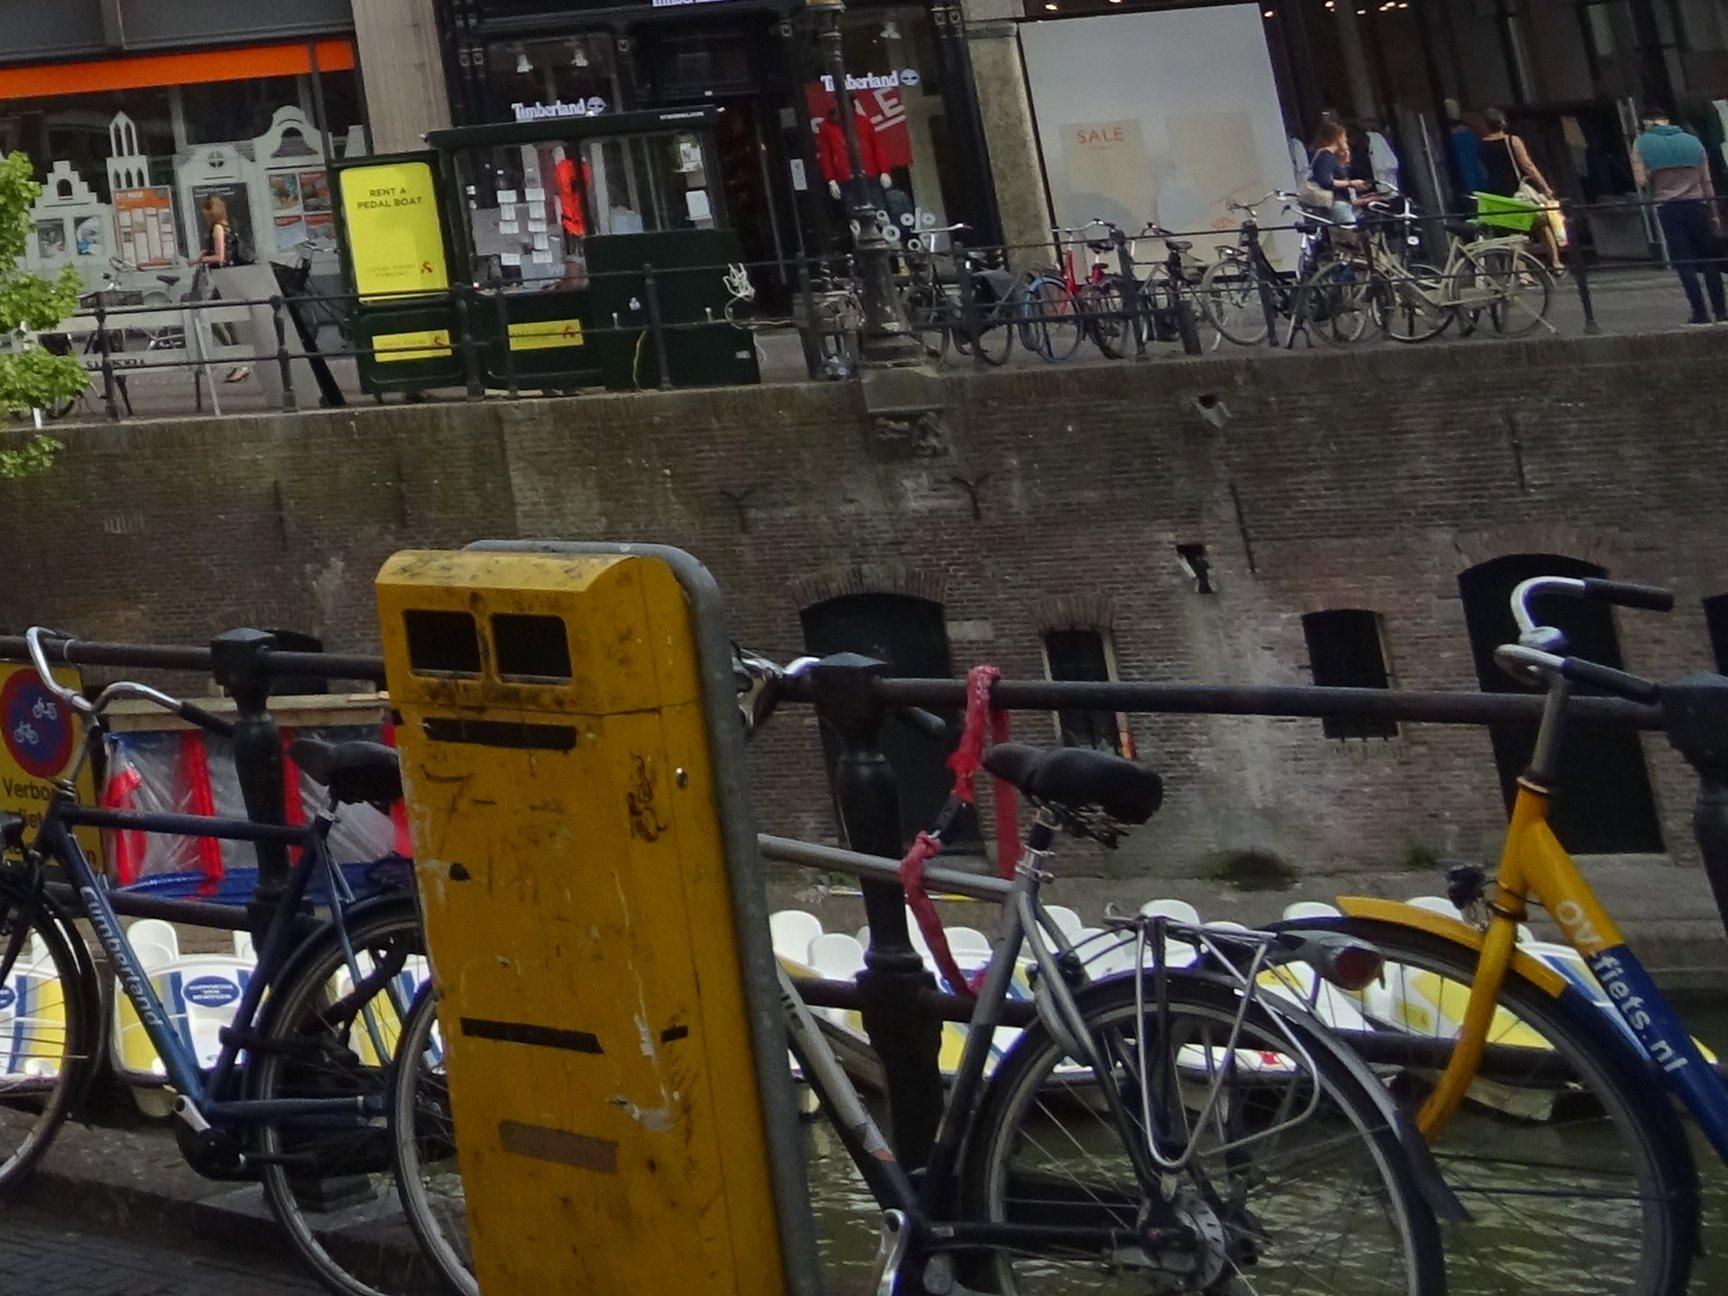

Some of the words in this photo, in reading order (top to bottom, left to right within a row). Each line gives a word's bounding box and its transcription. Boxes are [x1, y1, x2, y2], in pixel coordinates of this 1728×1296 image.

[820, 70, 899, 92] Tiberland
[511, 97, 586, 123] Timberland
[1076, 126, 1125, 145] SALE
[369, 187, 396, 198] RENT
[399, 187, 407, 195] A
[357, 199, 392, 210] PEDAL
[393, 196, 422, 207] BOAT
